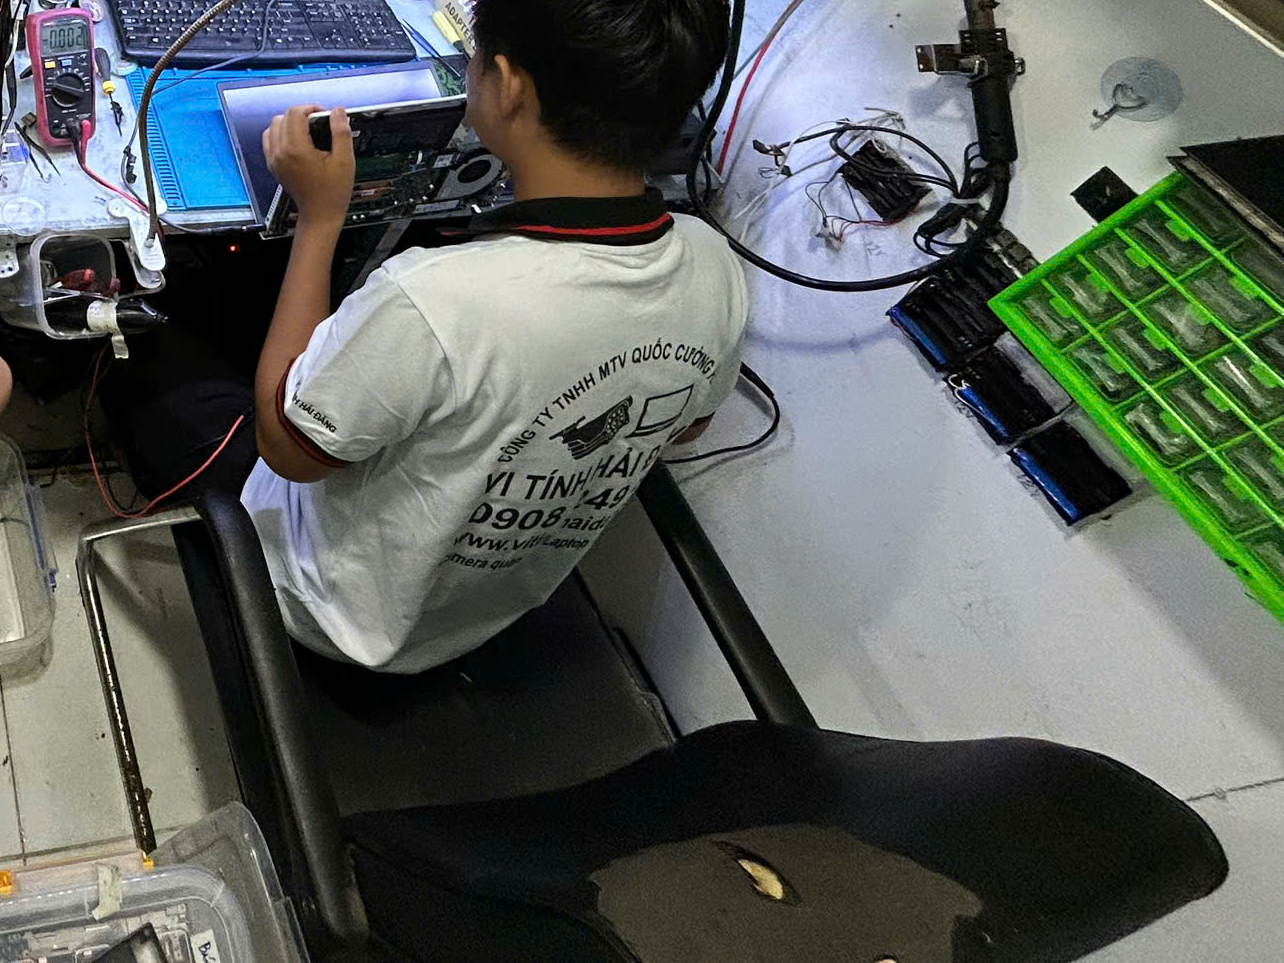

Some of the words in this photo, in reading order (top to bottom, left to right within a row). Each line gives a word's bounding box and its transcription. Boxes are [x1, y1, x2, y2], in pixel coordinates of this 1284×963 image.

[498, 430, 537, 463] CÔNG
[532, 407, 554, 427] TY
[552, 372, 596, 410] TNHH
[598, 351, 627, 381] MTV
[632, 337, 672, 363] QUỐC
[484, 471, 515, 497] VI
[597, 447, 644, 479] HẢI
[468, 501, 566, 530] 0908
